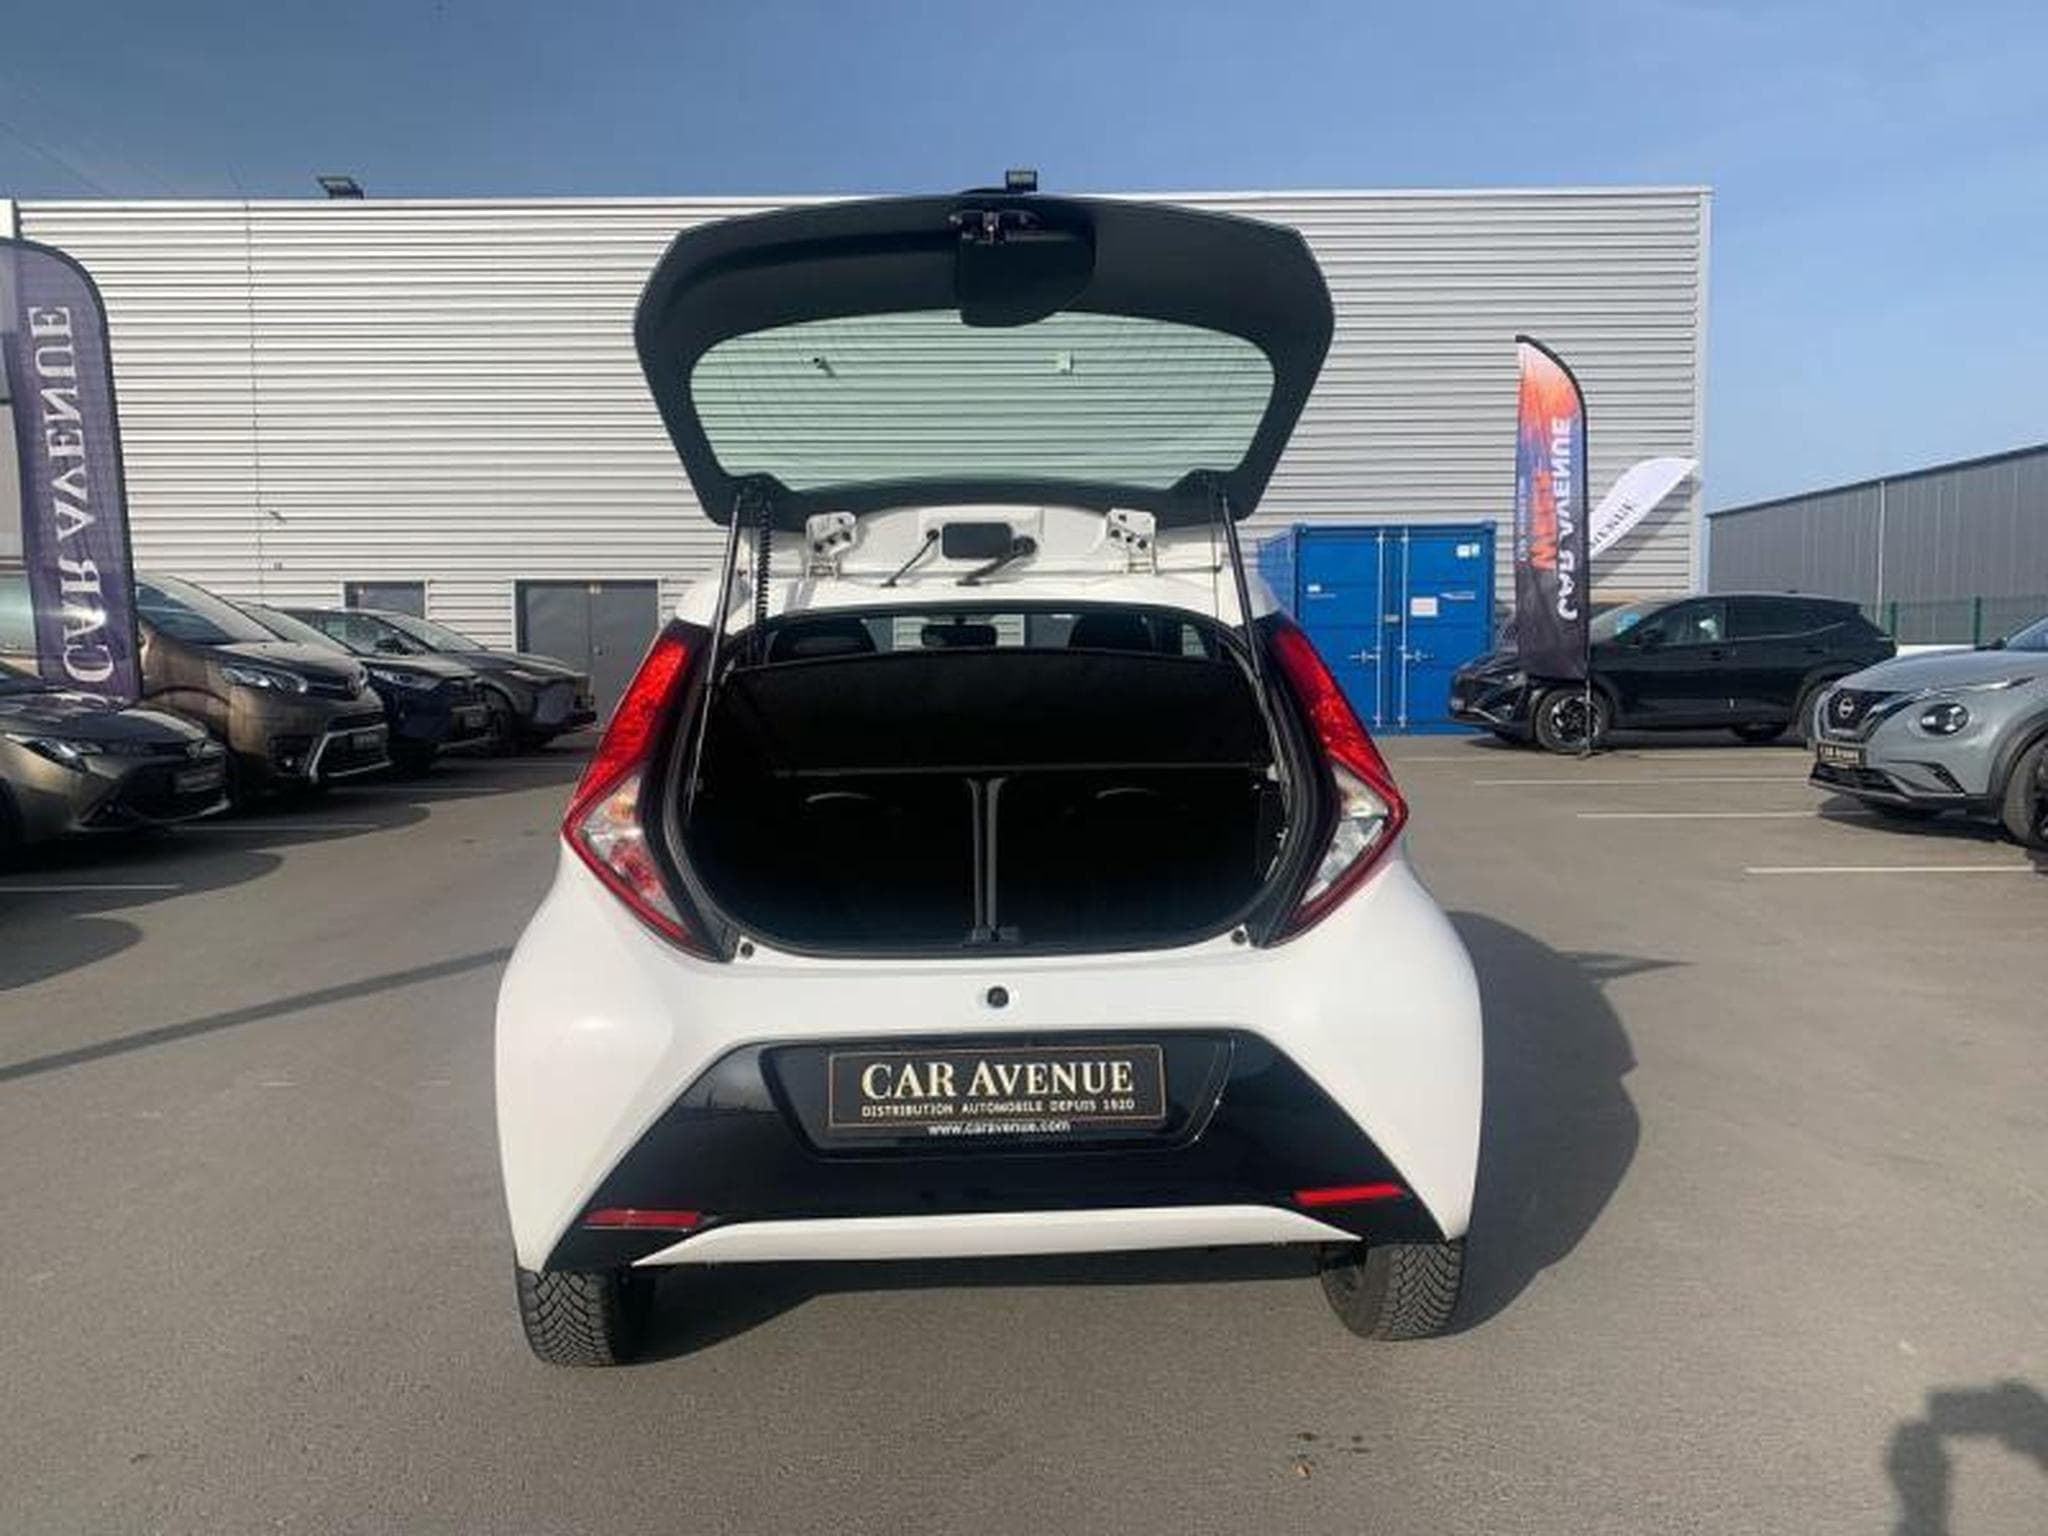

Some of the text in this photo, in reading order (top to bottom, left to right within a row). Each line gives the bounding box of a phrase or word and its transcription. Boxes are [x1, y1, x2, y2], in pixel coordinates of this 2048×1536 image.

[861, 1060, 1135, 1100] CAR AVENUE
[861, 1103, 954, 1118] DISTRIBUTION
[961, 1101, 1043, 1115] AUTOMOBILE
[1050, 1099, 1096, 1113] DEPUIS
